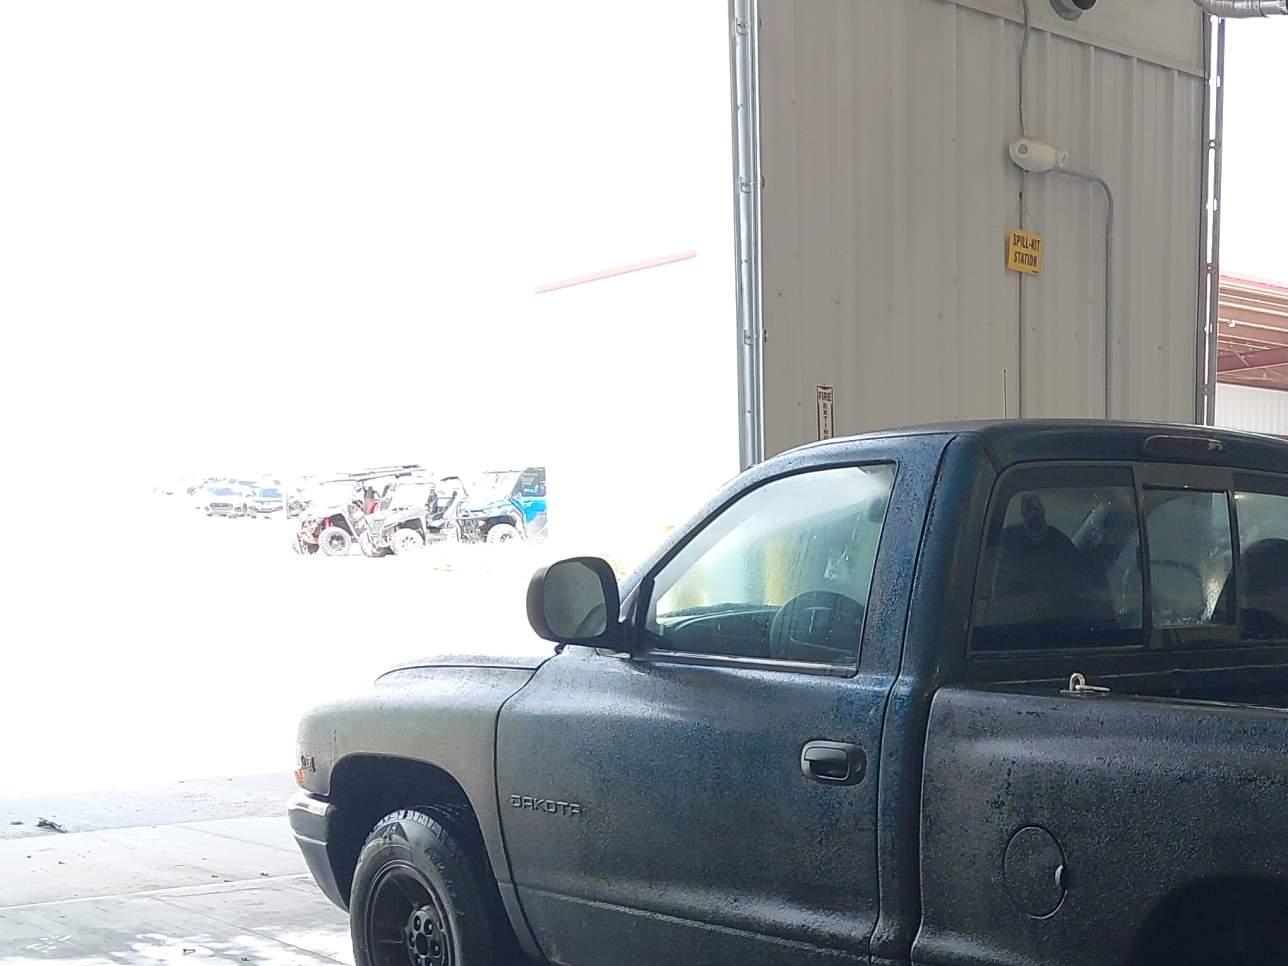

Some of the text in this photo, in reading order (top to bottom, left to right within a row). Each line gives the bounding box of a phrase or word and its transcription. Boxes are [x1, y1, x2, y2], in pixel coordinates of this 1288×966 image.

[1013, 233, 1041, 251] SPILL-KIT
[1013, 250, 1038, 267] STATION
[818, 391, 832, 402] FIRE
[510, 794, 581, 816] DAKOTA
